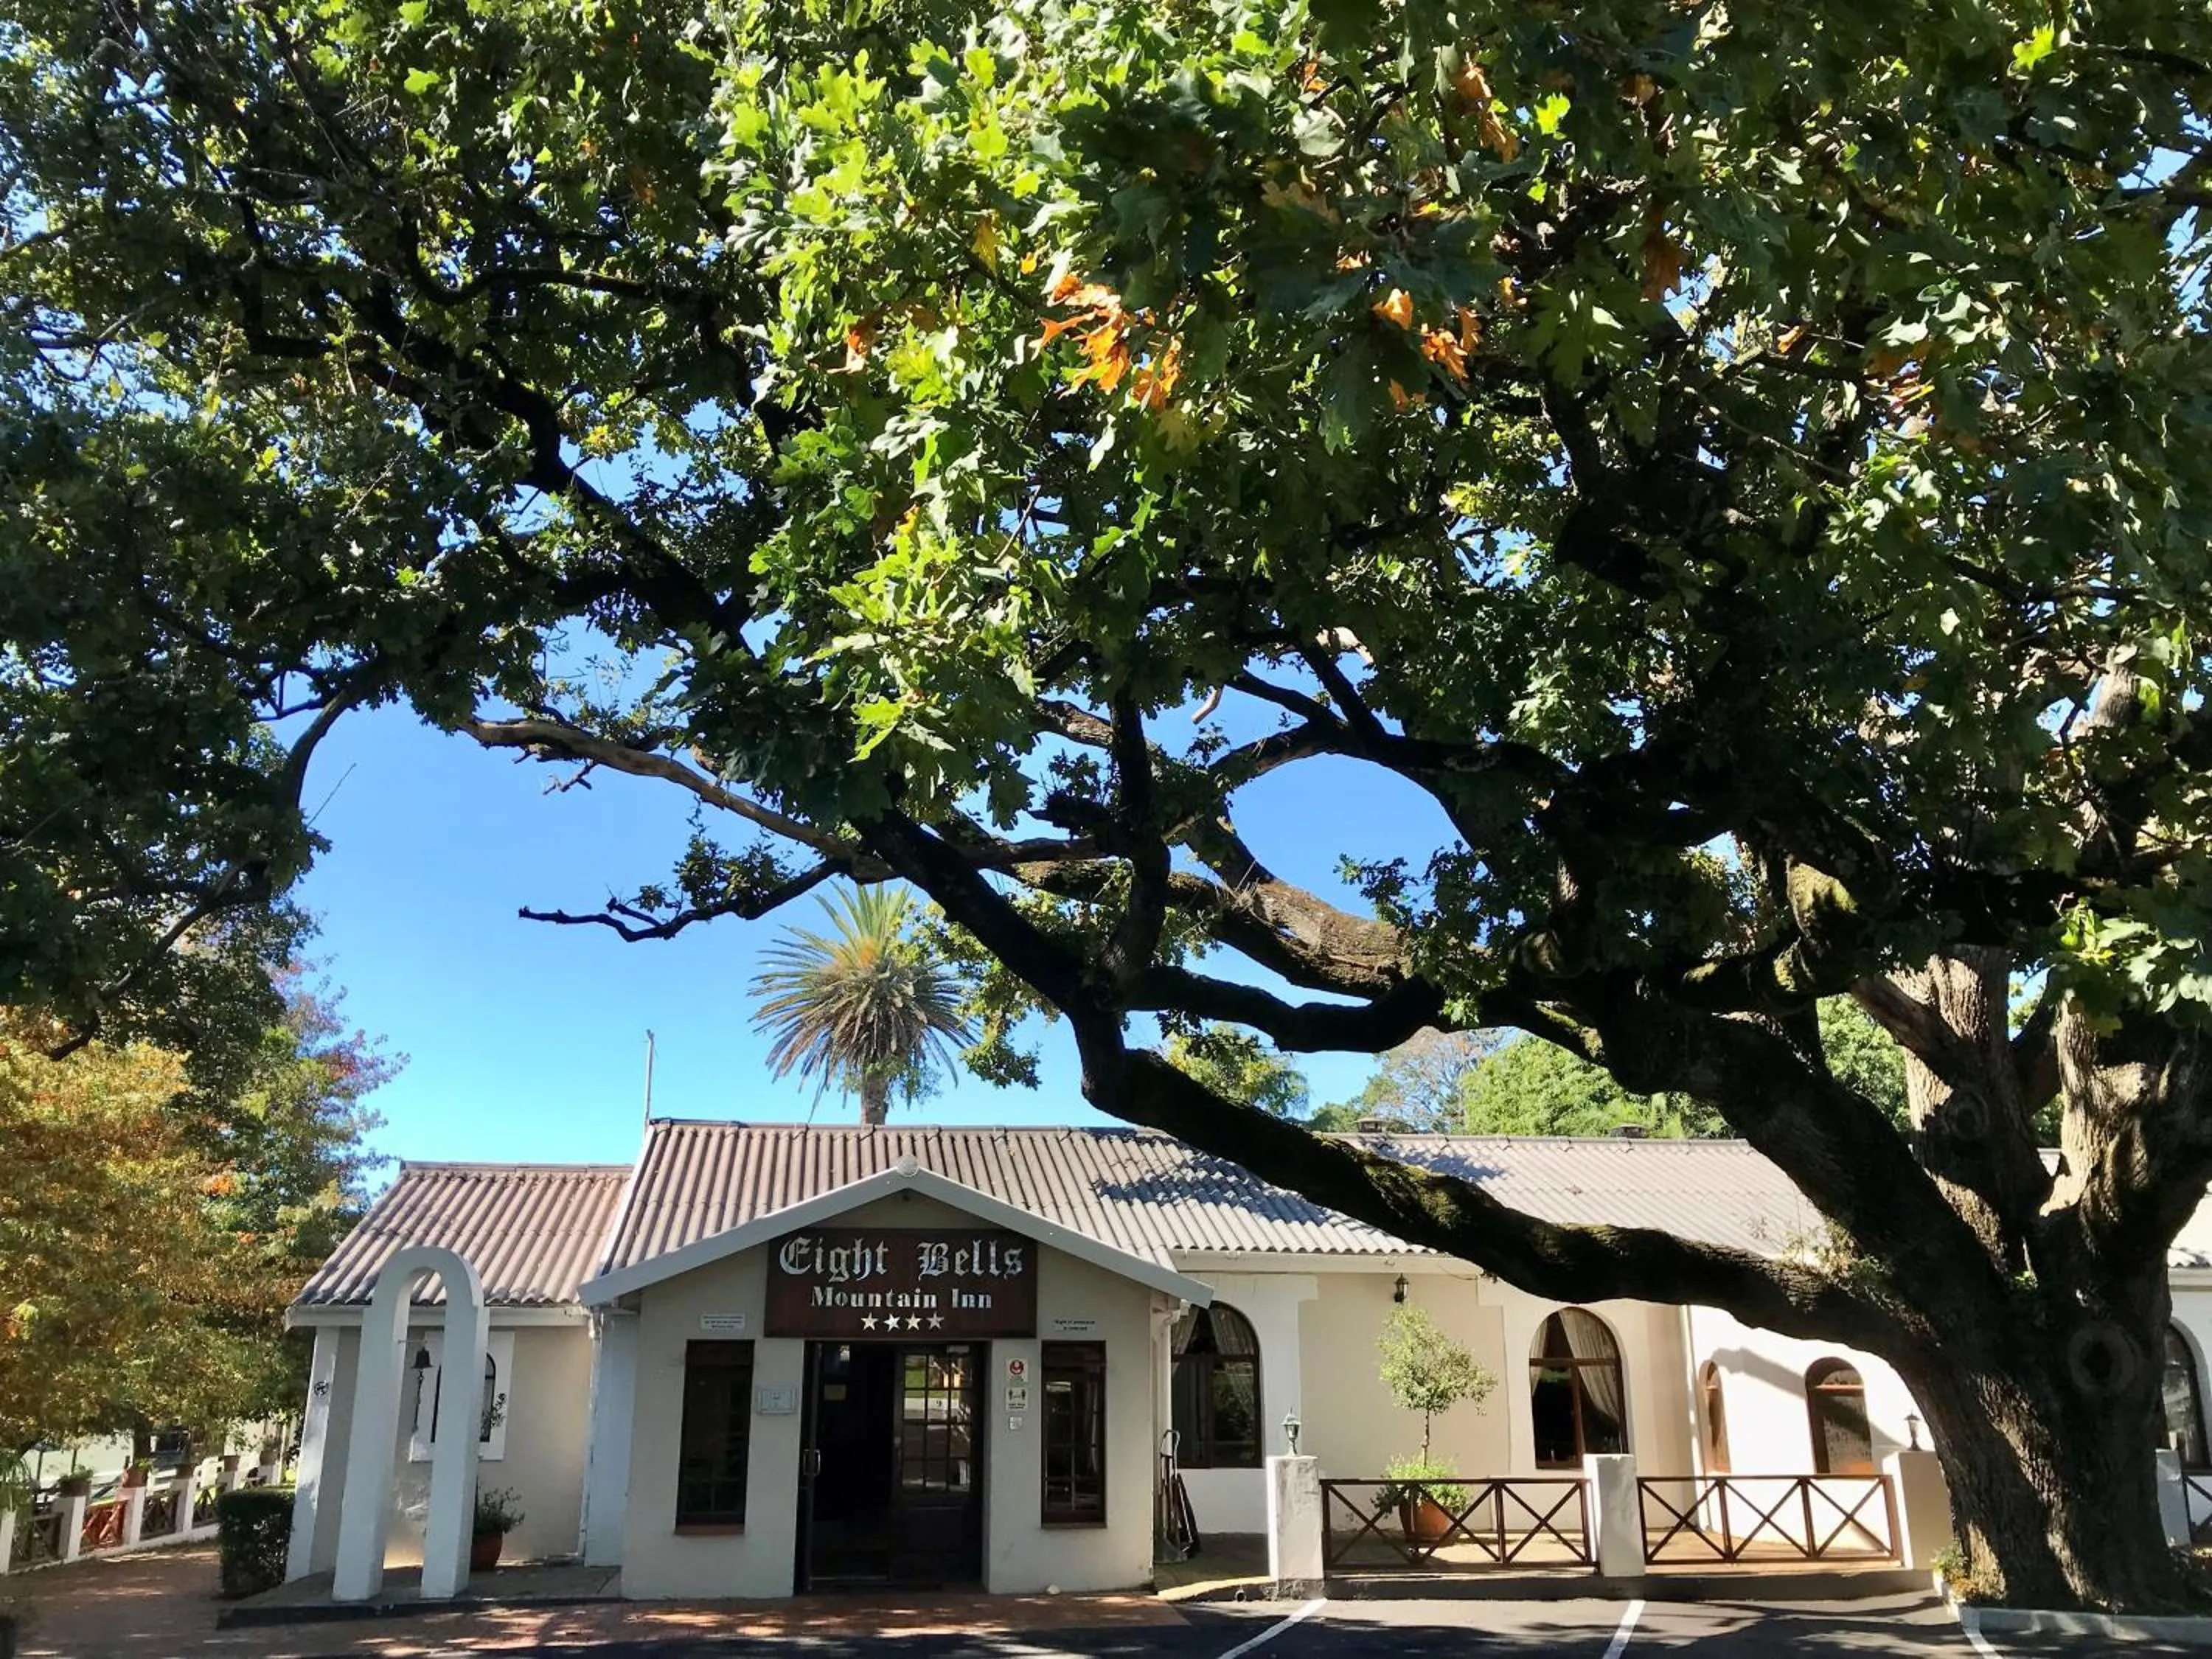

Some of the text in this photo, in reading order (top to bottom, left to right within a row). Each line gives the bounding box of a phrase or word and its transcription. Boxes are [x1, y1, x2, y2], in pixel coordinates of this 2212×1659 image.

[779, 1237, 1023, 1282] Eight Bells
[810, 1285, 992, 1309] Mountain Inn
